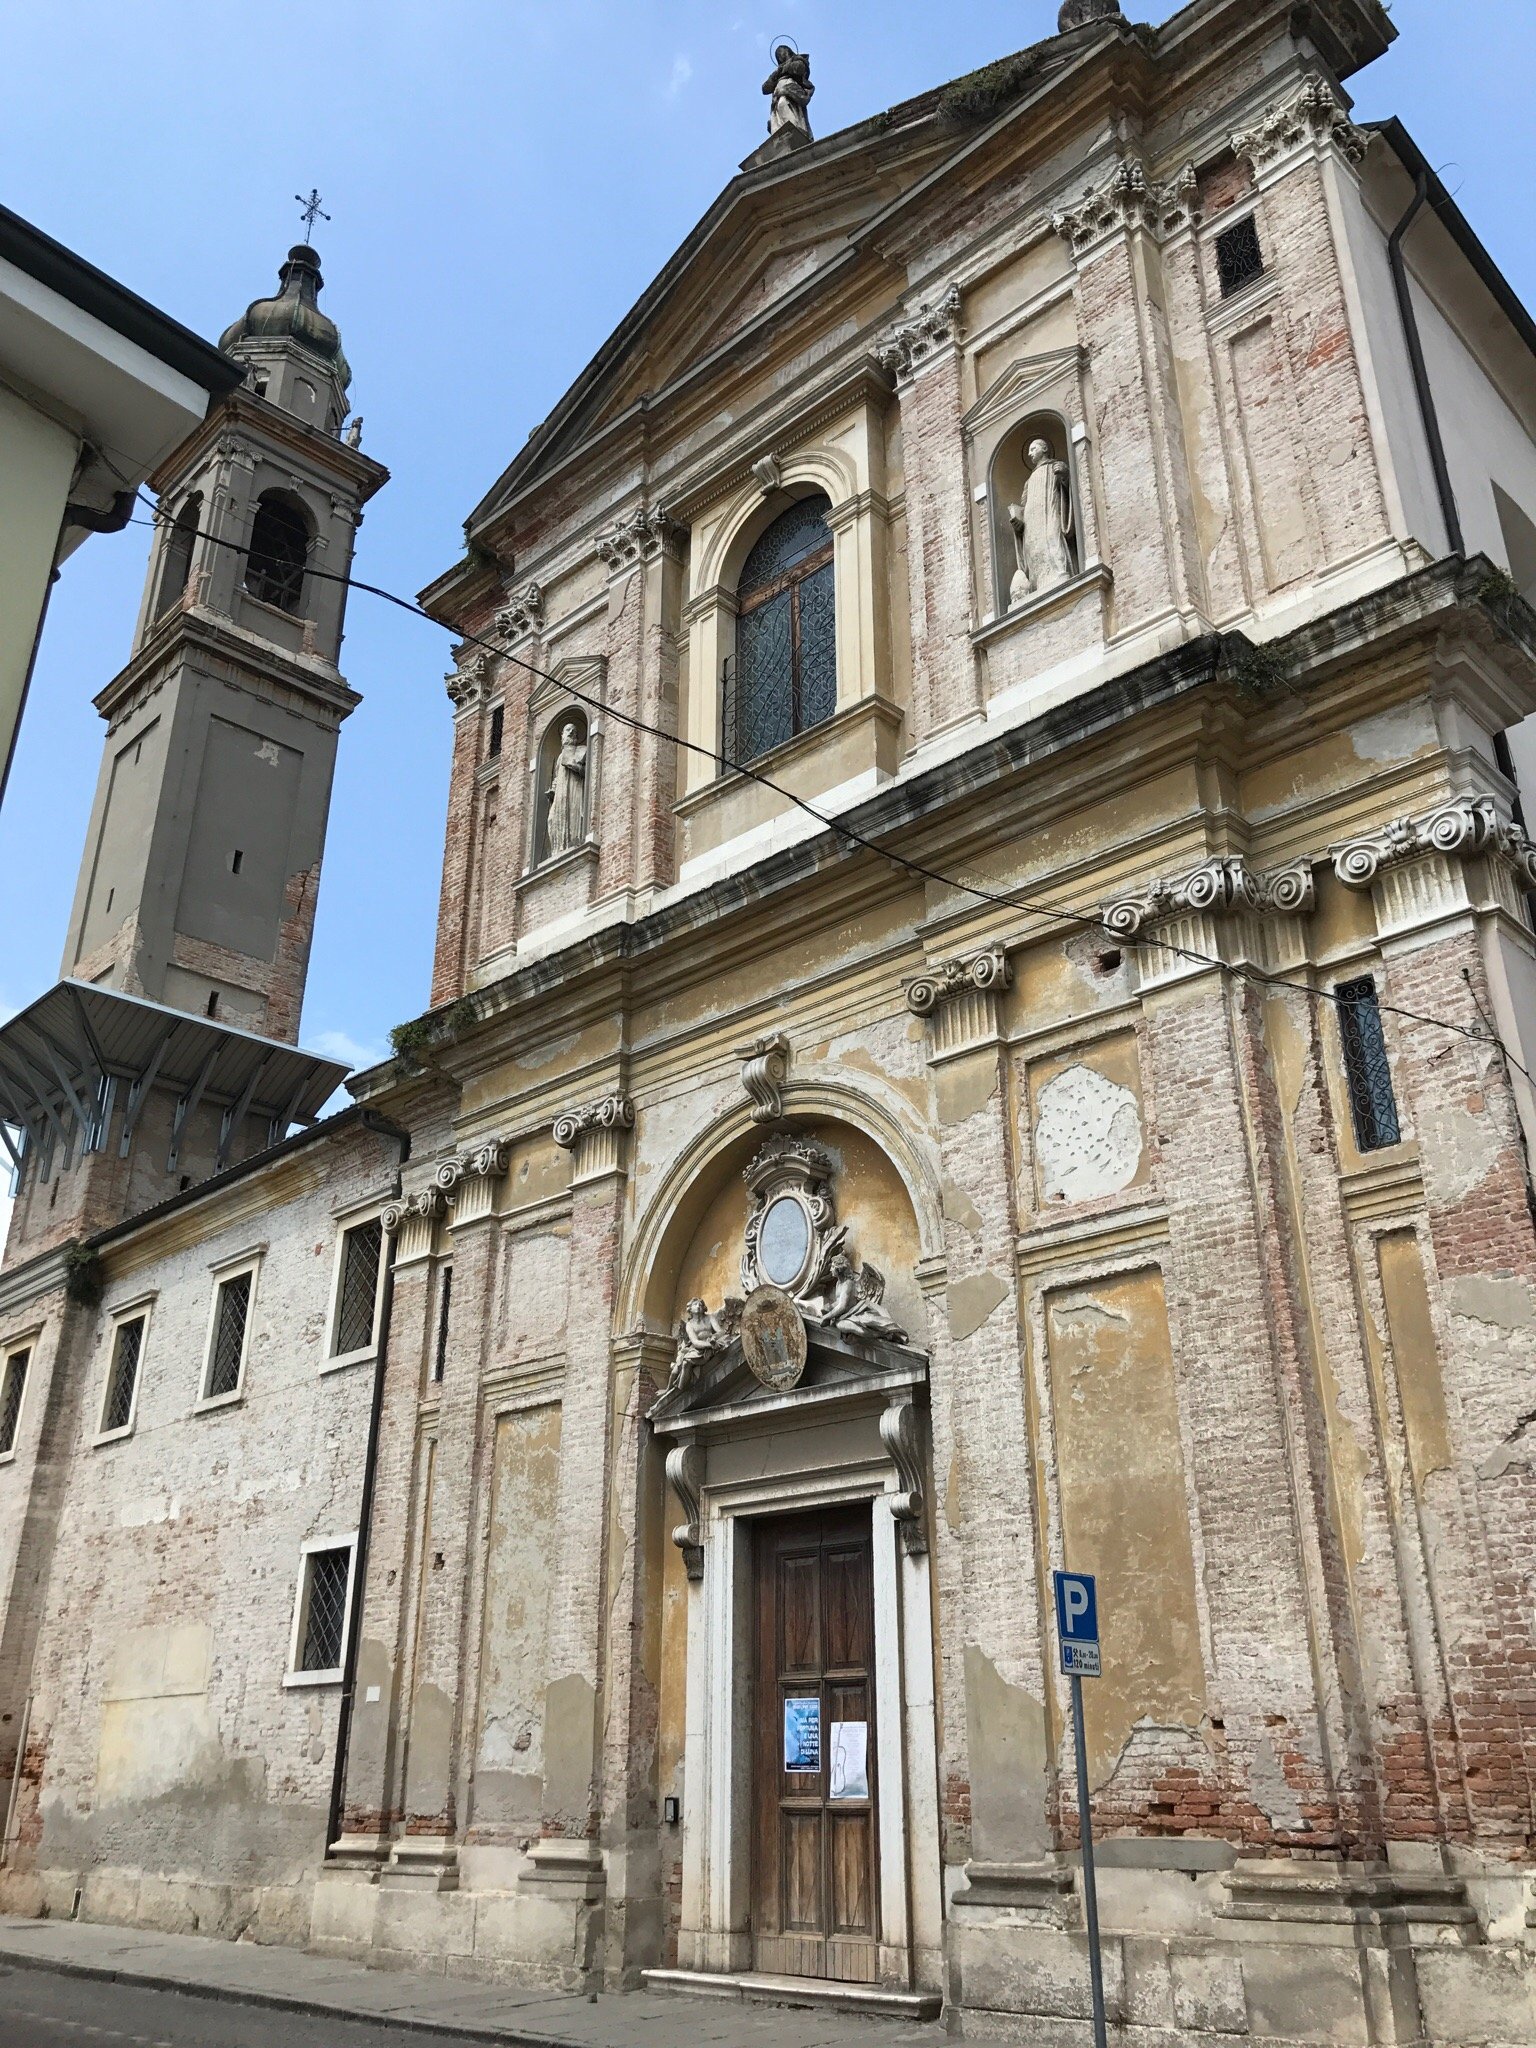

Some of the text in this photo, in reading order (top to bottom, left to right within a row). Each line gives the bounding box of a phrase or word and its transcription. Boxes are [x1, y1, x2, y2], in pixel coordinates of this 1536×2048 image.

[1063, 1579, 1088, 1633] P
[1074, 1659, 1099, 1671] 120 minuti
